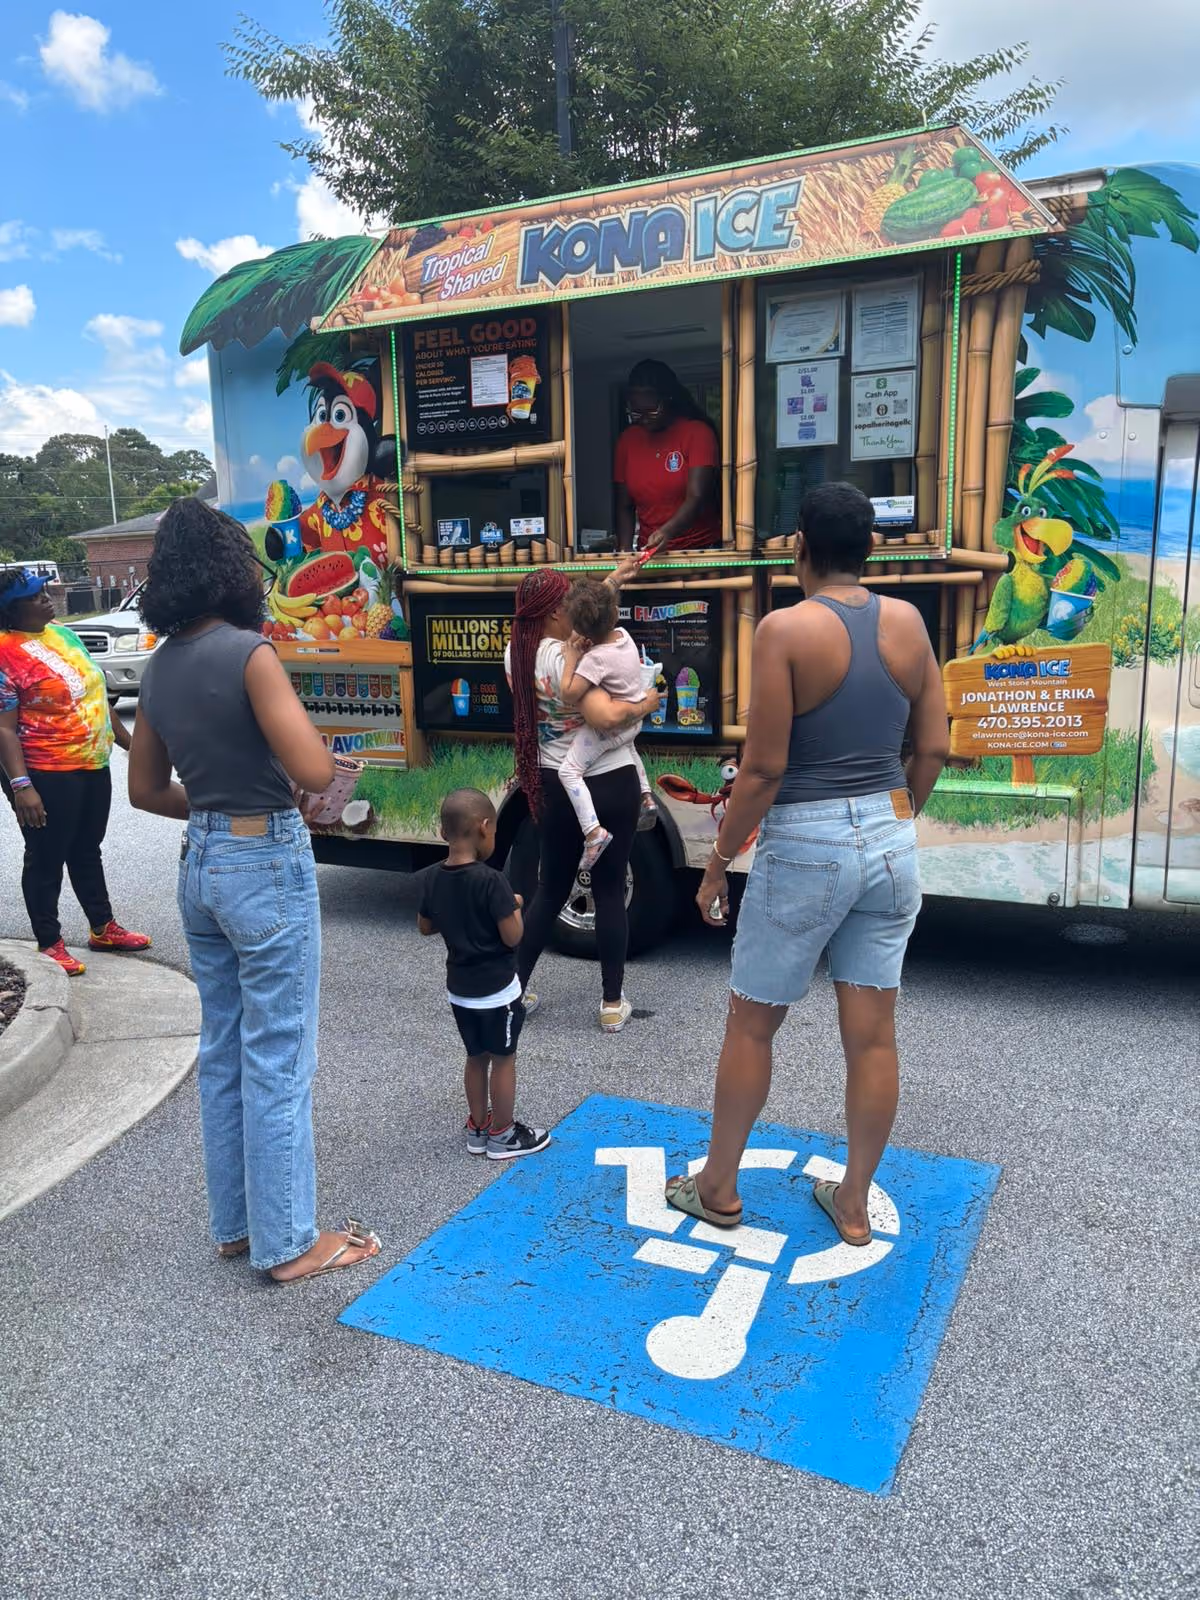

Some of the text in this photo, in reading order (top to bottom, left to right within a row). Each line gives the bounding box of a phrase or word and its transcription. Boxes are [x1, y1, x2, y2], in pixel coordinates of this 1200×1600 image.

[516, 176, 806, 288] KONA ICE
[422, 233, 494, 282] Tropical
[440, 253, 508, 299] Shaved
[414, 318, 537, 351] FEEL GOOD
[415, 338, 537, 360] ABOUT WHAT YOU'RE EATING
[415, 369, 445, 378] CALORIES
[865, 389, 898, 399] Cash App
[432, 619, 499, 634] MILLIONS
[442, 651, 471, 659] DOLLARS
[472, 651, 494, 659] GIVEN
[984, 659, 1070, 681] KONA ICE
[987, 678, 1068, 688] West Stone Mountain
[961, 688, 1096, 705] JONATHON & ERIKA
[990, 702, 1065, 715] LAWRENCE
[977, 715, 1083, 730] 470.395.2013
[972, 729, 1089, 740] elawrence@kona-ice.com
[987, 741, 1049, 749] KONA-ICE.COM
